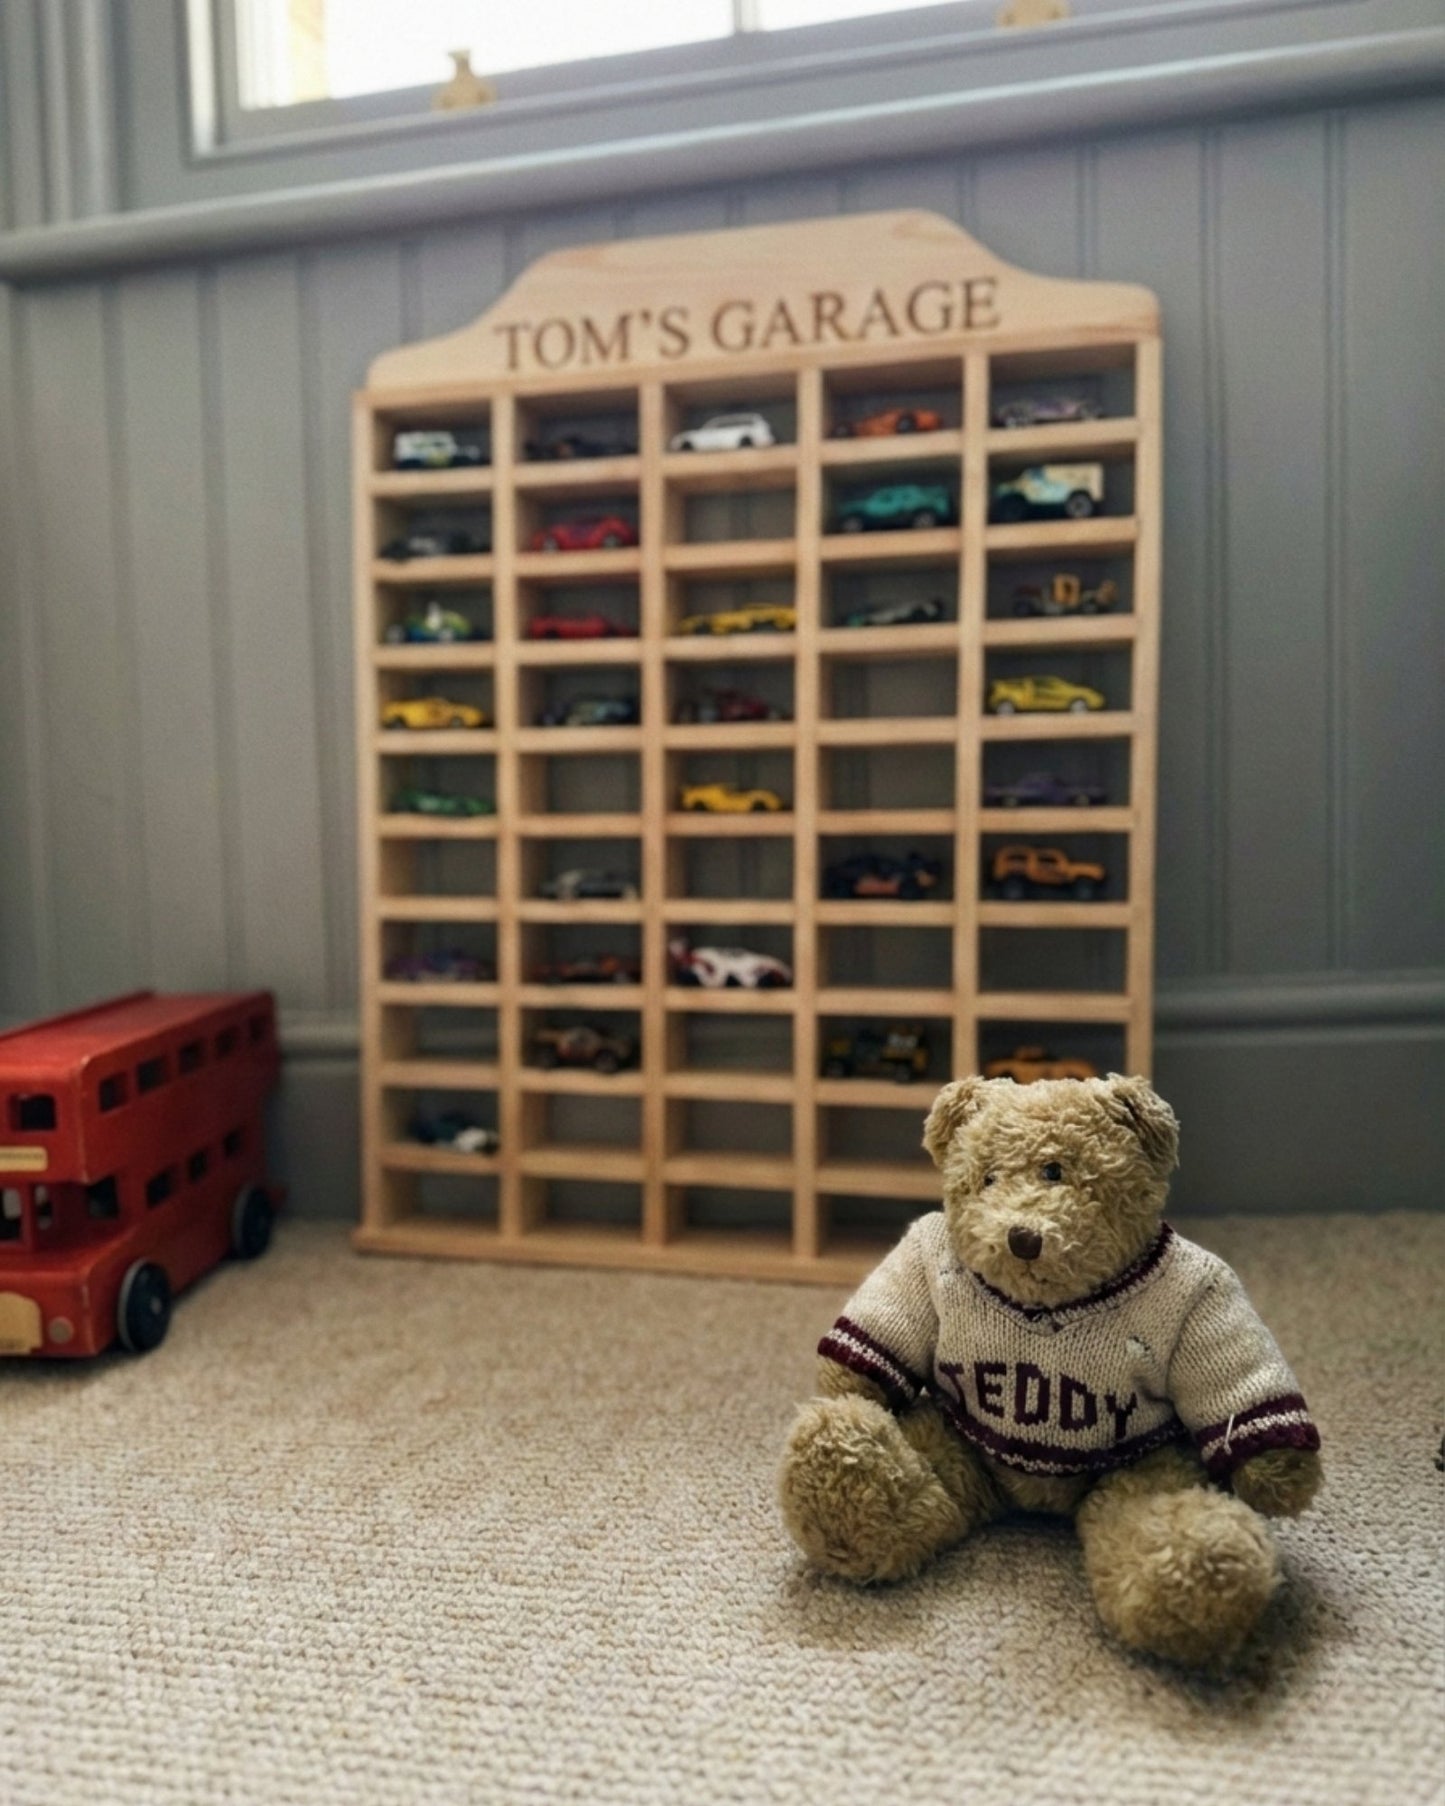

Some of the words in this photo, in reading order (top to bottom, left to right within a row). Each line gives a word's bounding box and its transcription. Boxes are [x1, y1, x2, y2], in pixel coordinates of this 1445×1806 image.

[494, 307, 690, 370] TOM'S
[711, 277, 1000, 351] GARAGE
[938, 1361, 1137, 1440] TEDDY
